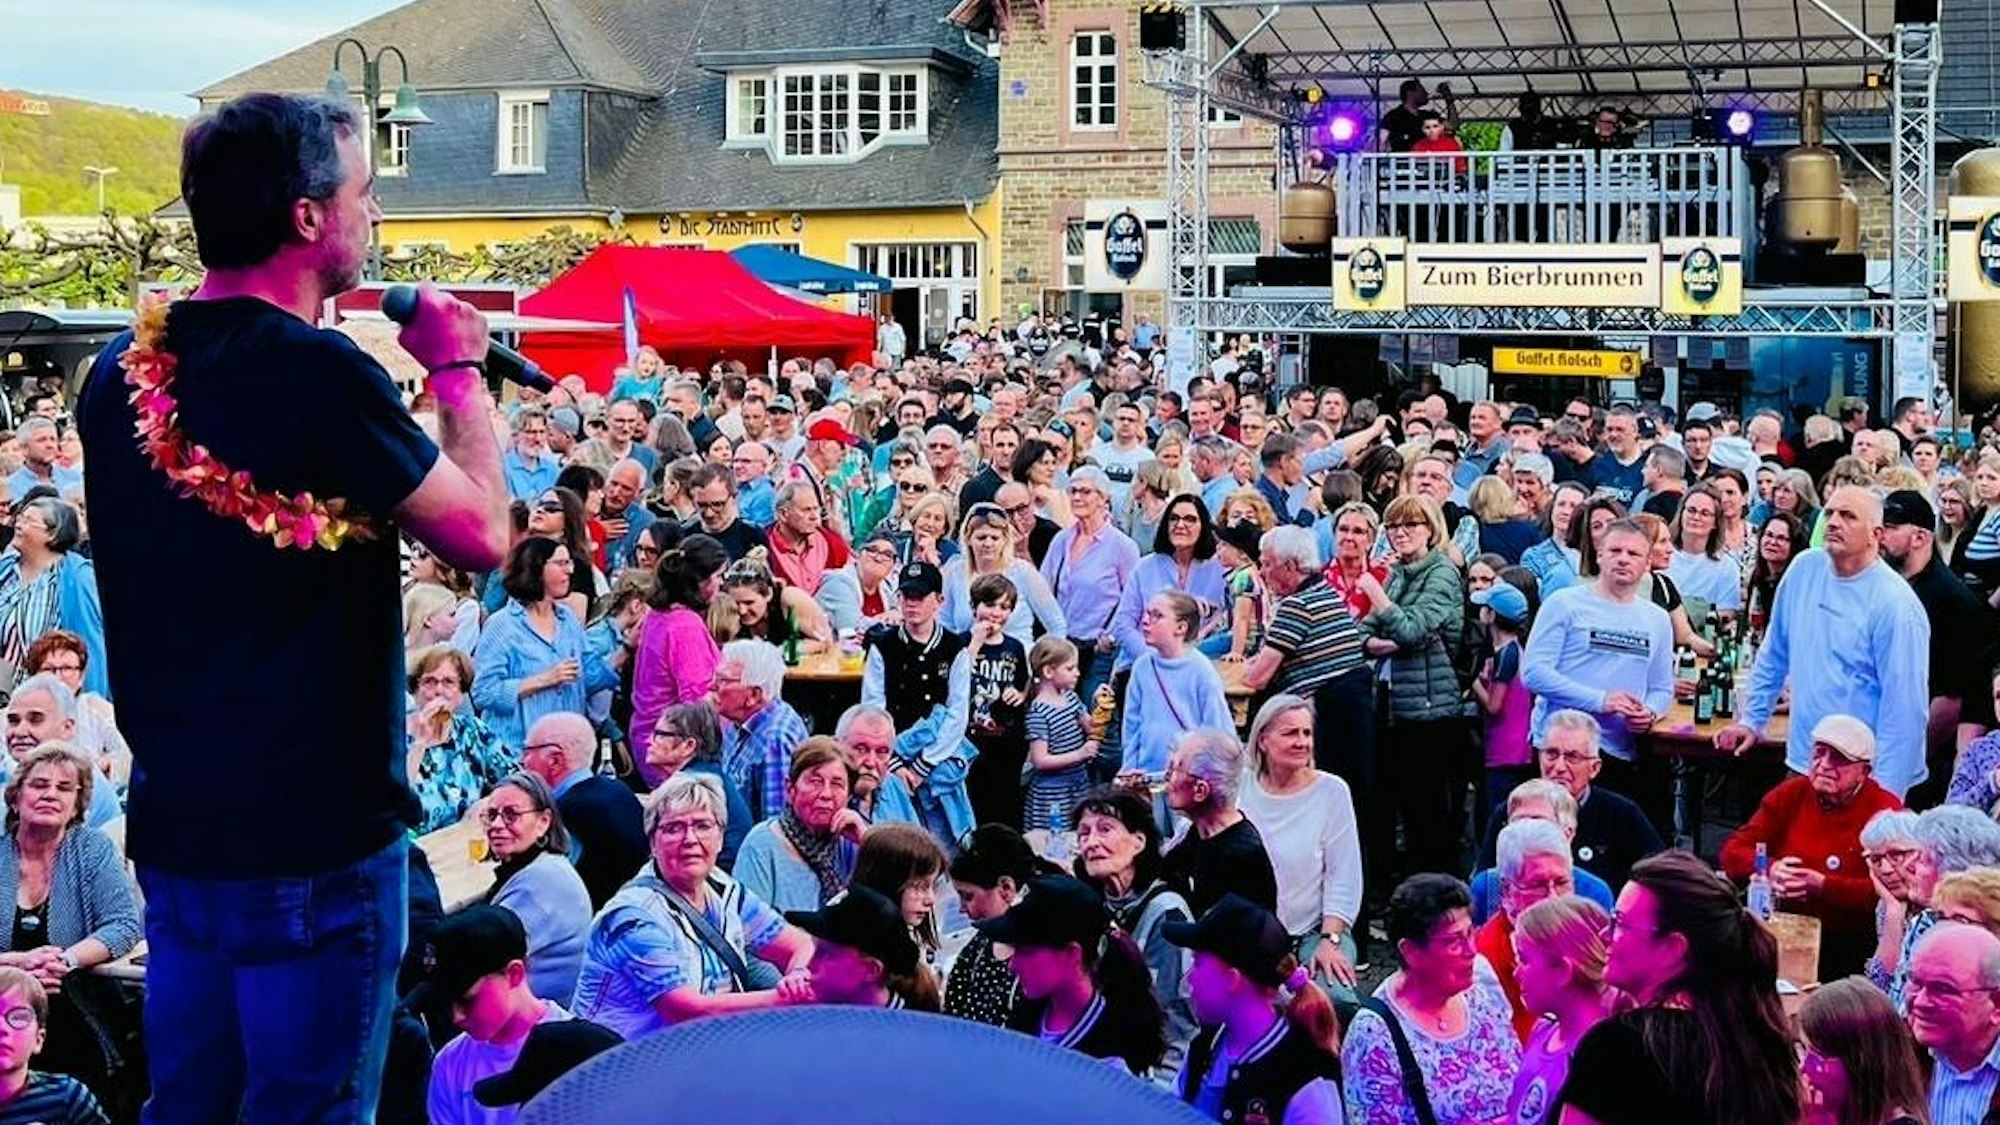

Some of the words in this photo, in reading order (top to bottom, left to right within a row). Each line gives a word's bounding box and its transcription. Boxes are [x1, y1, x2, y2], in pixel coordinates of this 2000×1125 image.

[1106, 236, 1143, 254] Gaffel
[1422, 264, 1477, 287] Zum
[1487, 264, 1644, 287] Bierbrunnen
[1516, 350, 1555, 366] Gaffel
